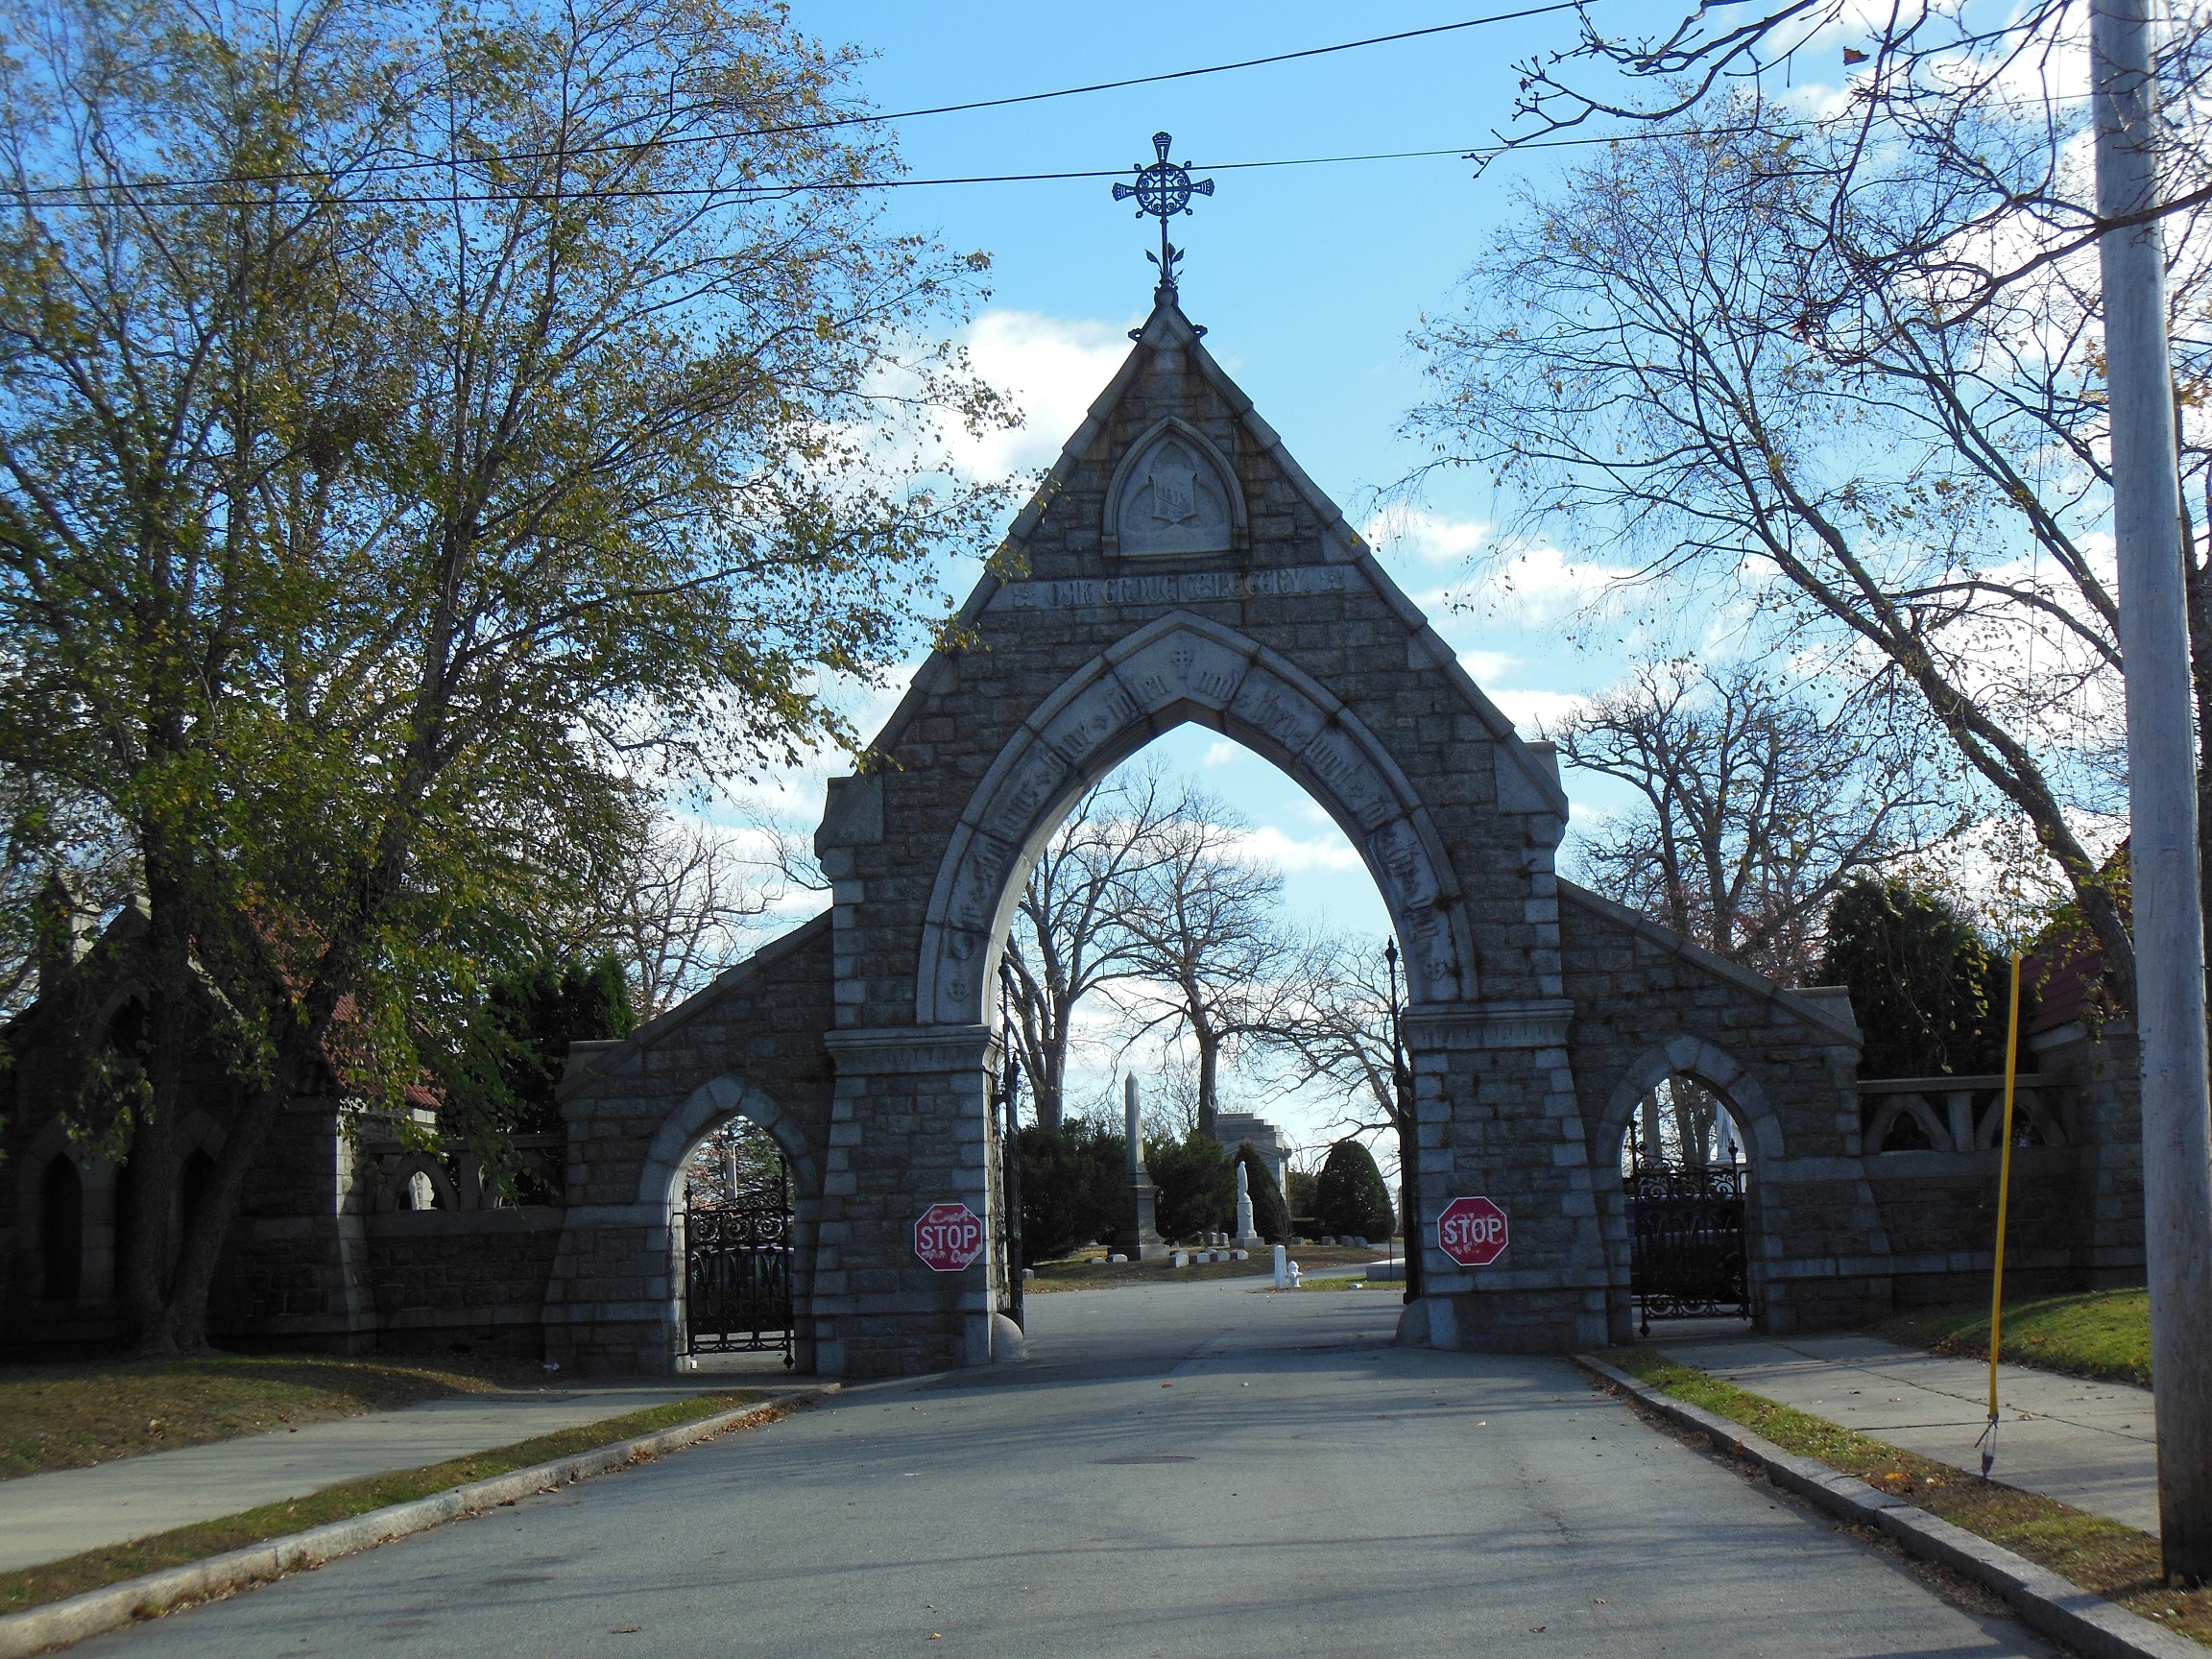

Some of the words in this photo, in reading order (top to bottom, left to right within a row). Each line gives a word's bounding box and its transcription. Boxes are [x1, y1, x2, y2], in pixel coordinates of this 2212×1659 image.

[1046, 582, 1094, 606] OAK
[1100, 576, 1176, 604] GROVE
[1180, 568, 1308, 600] CEMETERY
[920, 1224, 977, 1250] STOP
[1444, 1217, 1503, 1244] STOP
